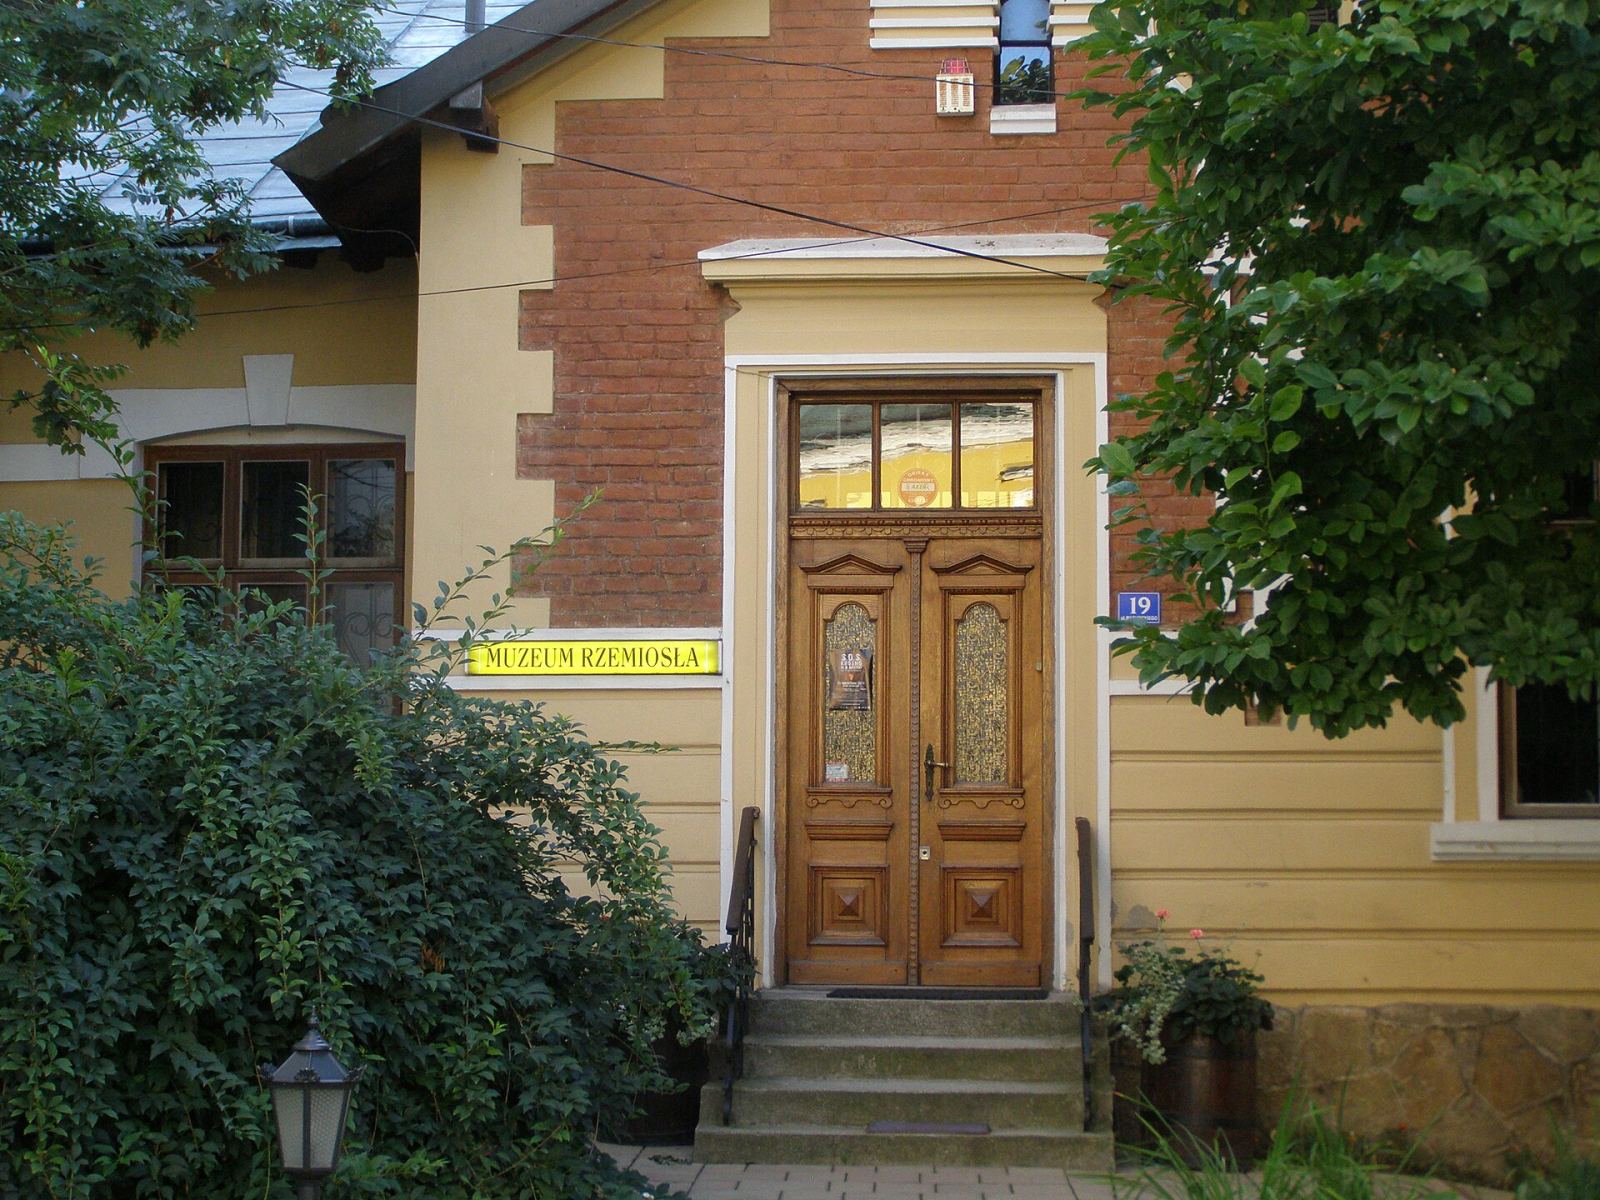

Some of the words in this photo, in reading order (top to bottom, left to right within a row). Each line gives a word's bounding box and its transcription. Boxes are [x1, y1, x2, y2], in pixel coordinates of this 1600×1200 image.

[1129, 596, 1151, 615] 19
[486, 647, 574, 668] MUZEUM
[581, 646, 700, 668] RZEMIOSŁA
